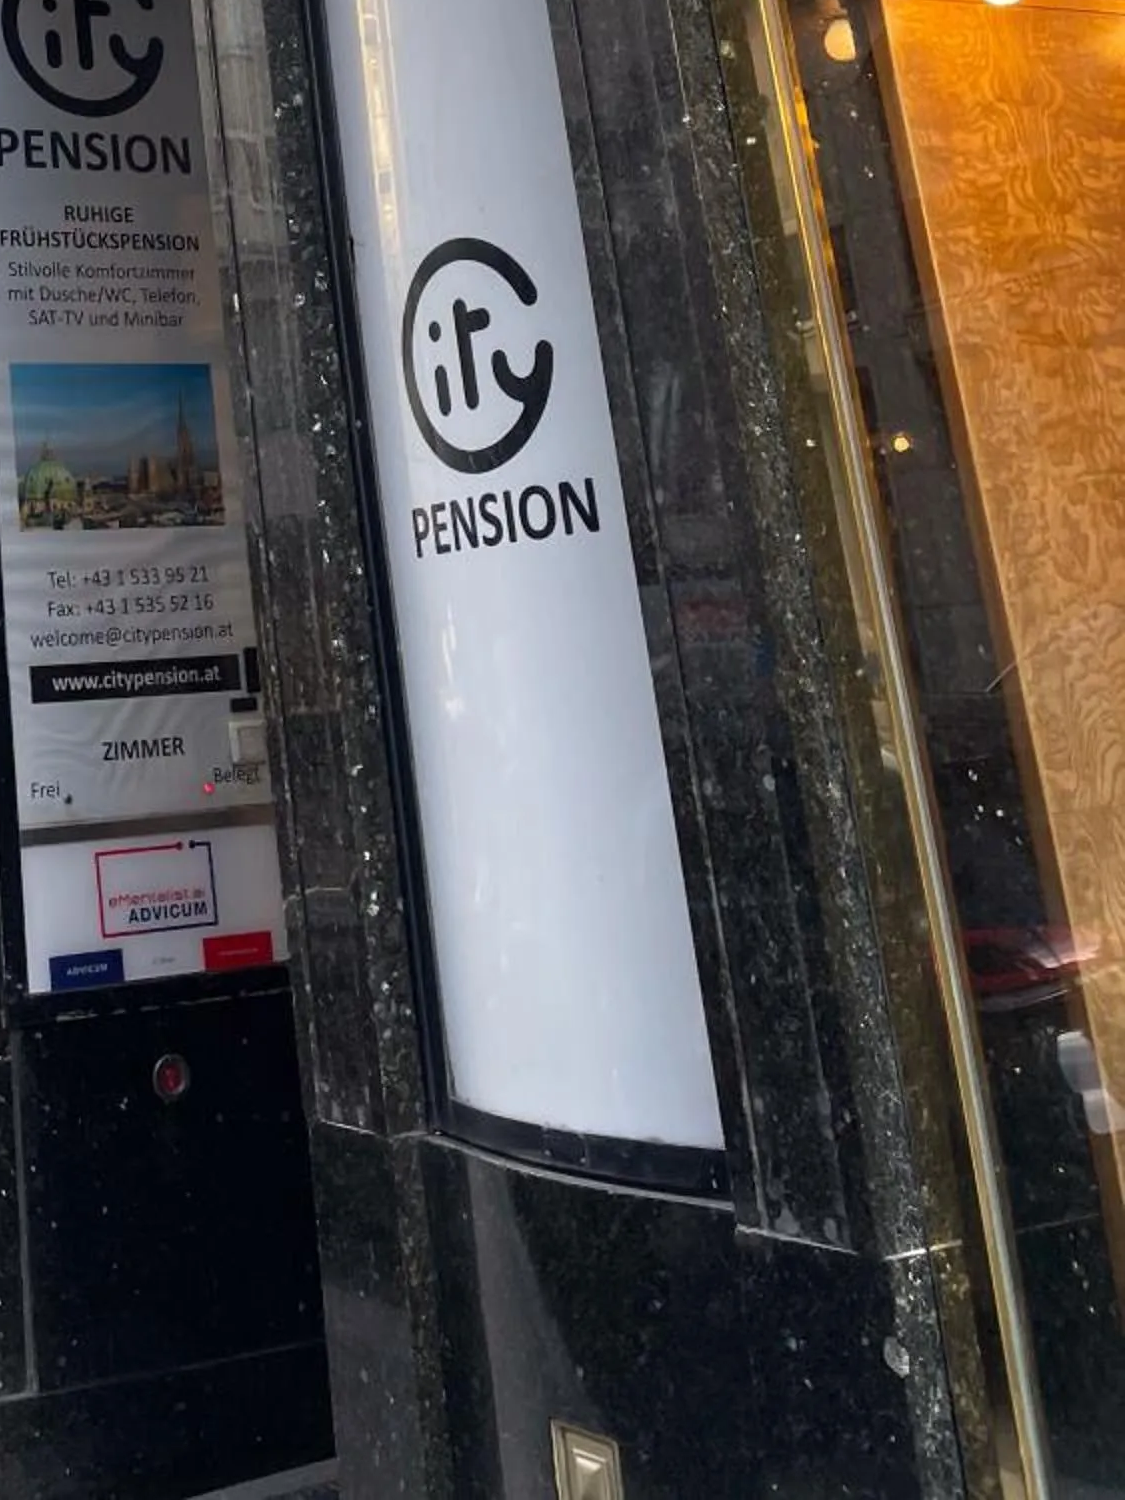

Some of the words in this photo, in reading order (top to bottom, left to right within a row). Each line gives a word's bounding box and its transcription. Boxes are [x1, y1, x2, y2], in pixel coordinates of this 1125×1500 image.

[64, 205, 135, 223] RUHIGE
[0, 226, 199, 252] FRÜHSTÜCKSPENSION
[8, 261, 72, 278] Stilvolle
[75, 263, 195, 280] Komfortzimmer
[8, 287, 34, 301] mit
[39, 285, 136, 304] Dusche/WC,
[139, 287, 201, 307] Telefon,
[28, 309, 84, 326] SAT-TV
[89, 311, 119, 327] und
[124, 311, 184, 328] Minibar
[411, 477, 601, 559] PENSION
[83, 569, 111, 587] +43
[117, 569, 125, 586] 1
[130, 566, 160, 586] 533
[190, 564, 210, 583] 21
[47, 600, 81, 618] Fax:
[87, 598, 116, 616] +43
[121, 597, 129, 615] 1
[30, 620, 235, 649] welcome@citypension.at
[52, 665, 222, 692] www.citypension.at
[103, 736, 186, 762] ZIMMER
[30, 780, 61, 800] Frei
[128, 901, 208, 924] ADVICUM
